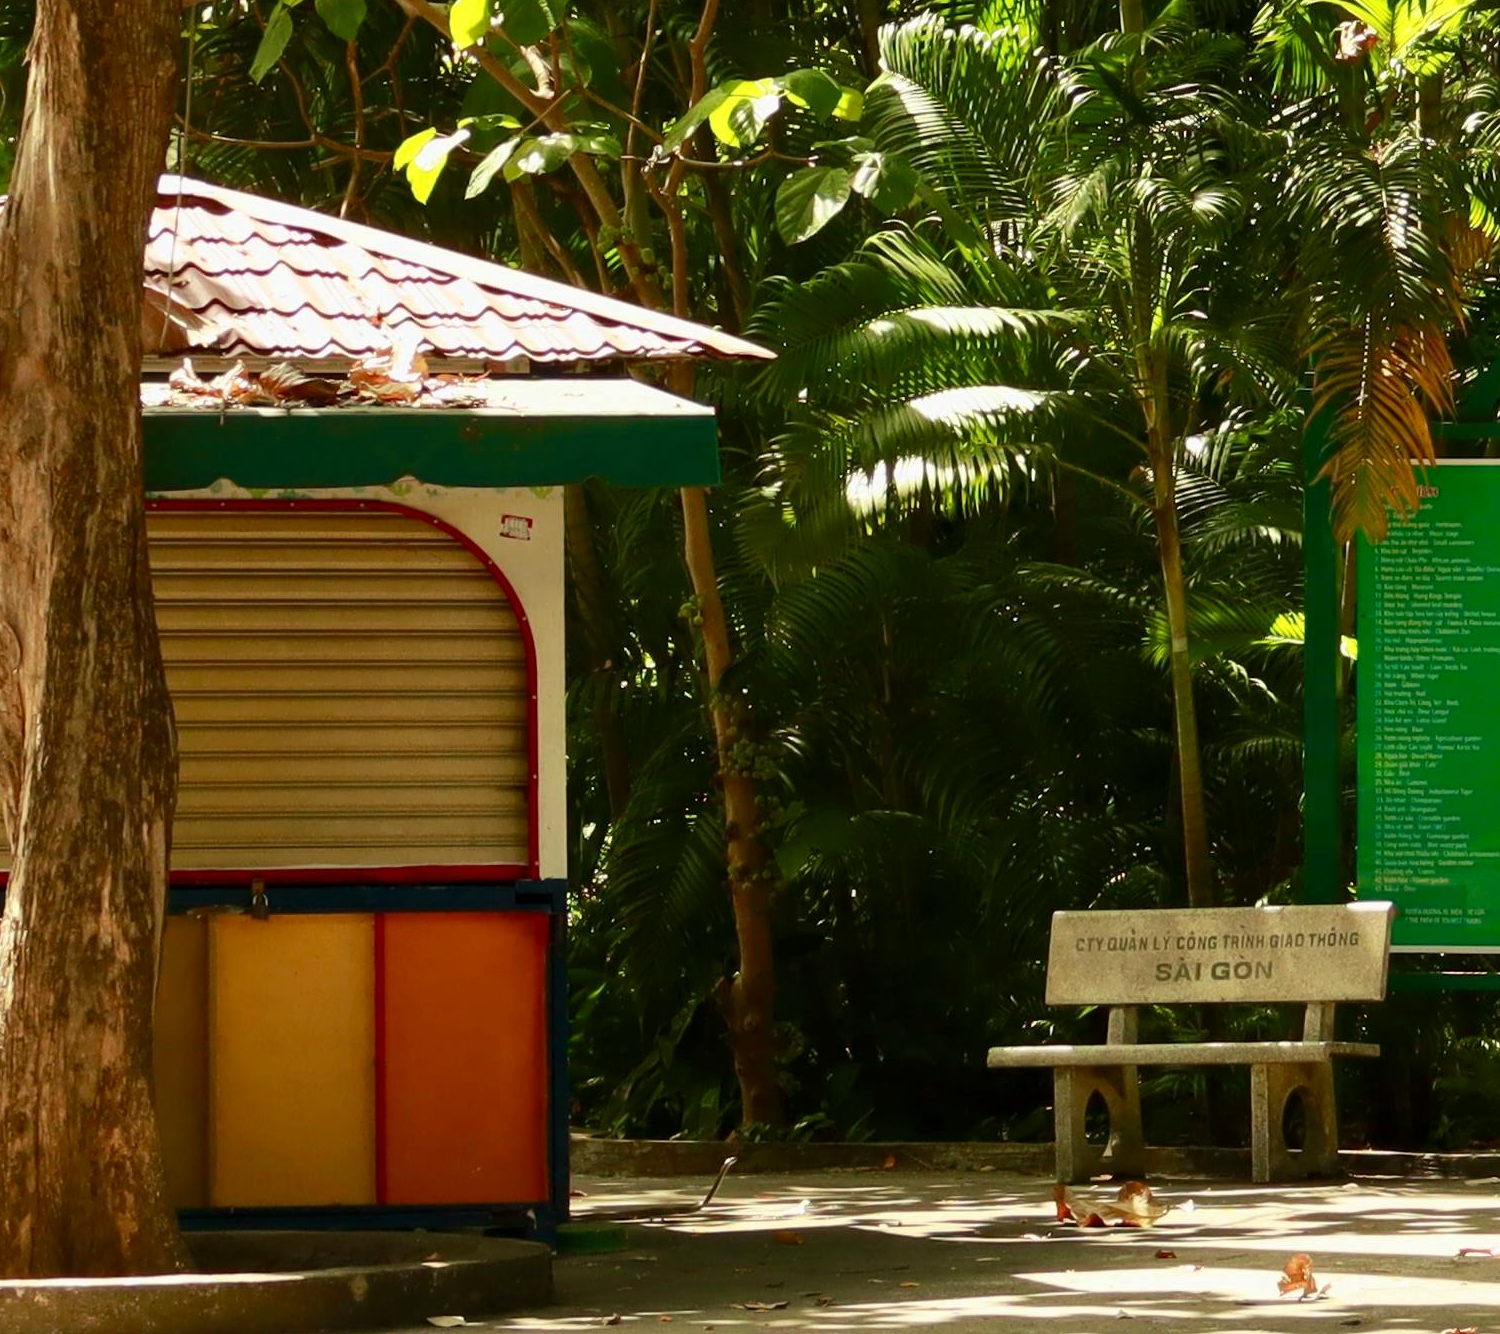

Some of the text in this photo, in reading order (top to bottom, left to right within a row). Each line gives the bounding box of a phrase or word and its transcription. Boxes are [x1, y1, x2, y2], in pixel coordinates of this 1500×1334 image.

[1076, 937, 1103, 952] CTY
[1153, 930, 1171, 951] LÝ
[1176, 930, 1218, 951] CÔNG
[1223, 925, 1265, 950] TRÌNH
[1269, 933, 1305, 949] GIAO
[1309, 926, 1360, 948] THÔNG
[1155, 954, 1273, 982] SÀI GÒN
